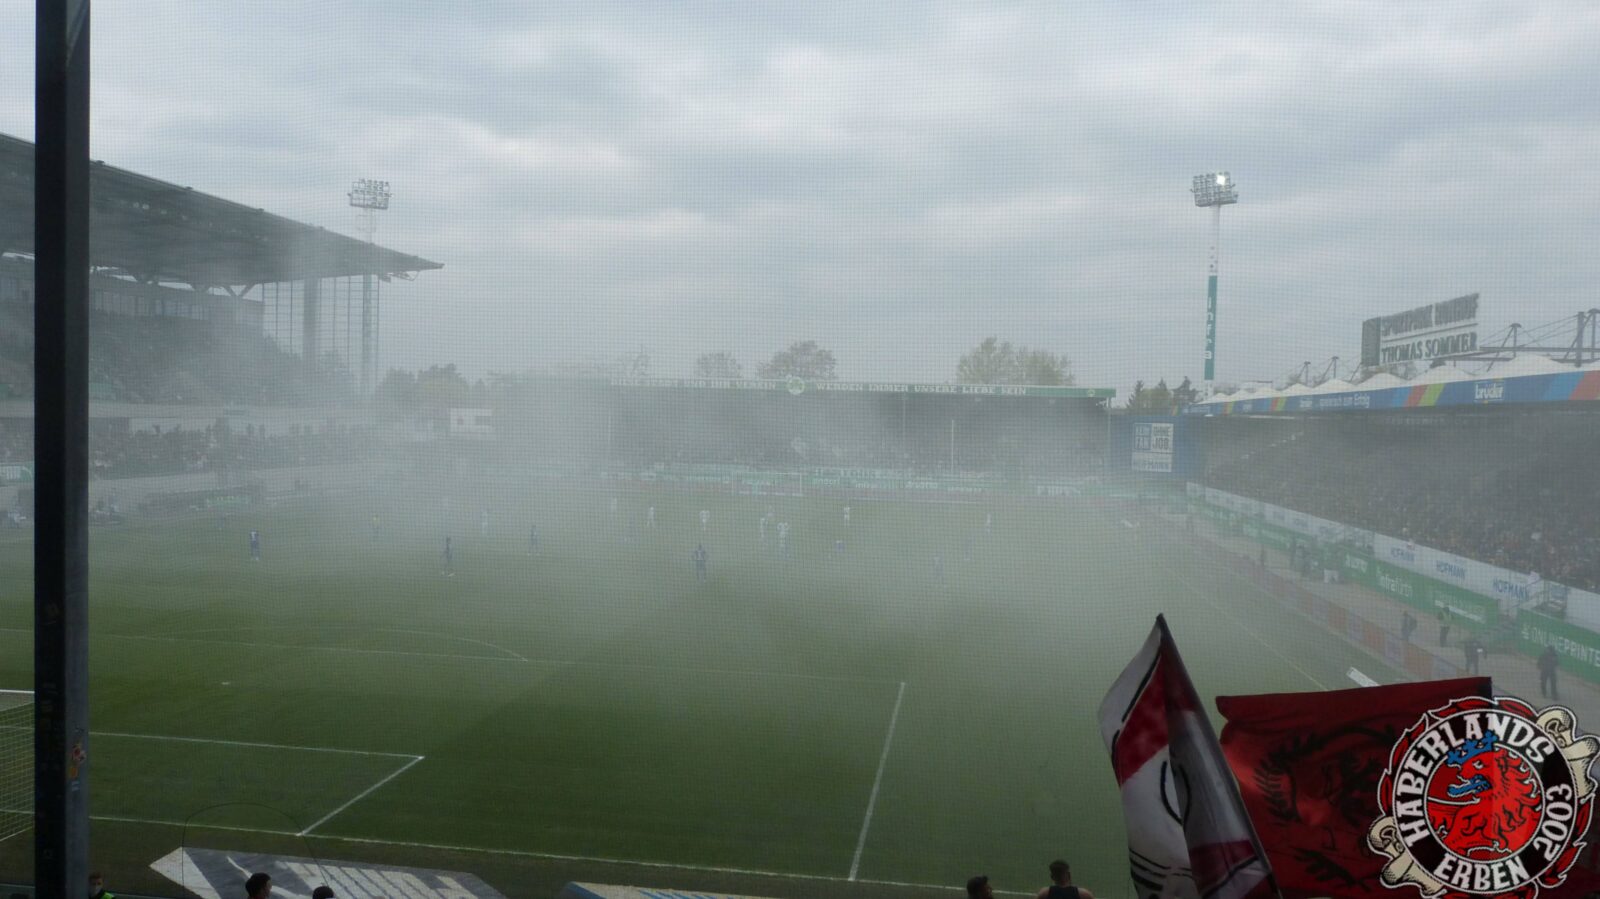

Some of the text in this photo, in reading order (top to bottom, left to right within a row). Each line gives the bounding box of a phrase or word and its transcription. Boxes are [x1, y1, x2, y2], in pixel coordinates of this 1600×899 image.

[1382, 331, 1478, 364] THOMAS SOMMER
[816, 382, 863, 391] WERDEN
[868, 383, 908, 392] IMMER
[914, 384, 957, 393] UNSERE
[962, 385, 995, 394] LIEBE
[1436, 560, 1466, 580] HOFMANN
[1492, 578, 1530, 602] HOFMANN
